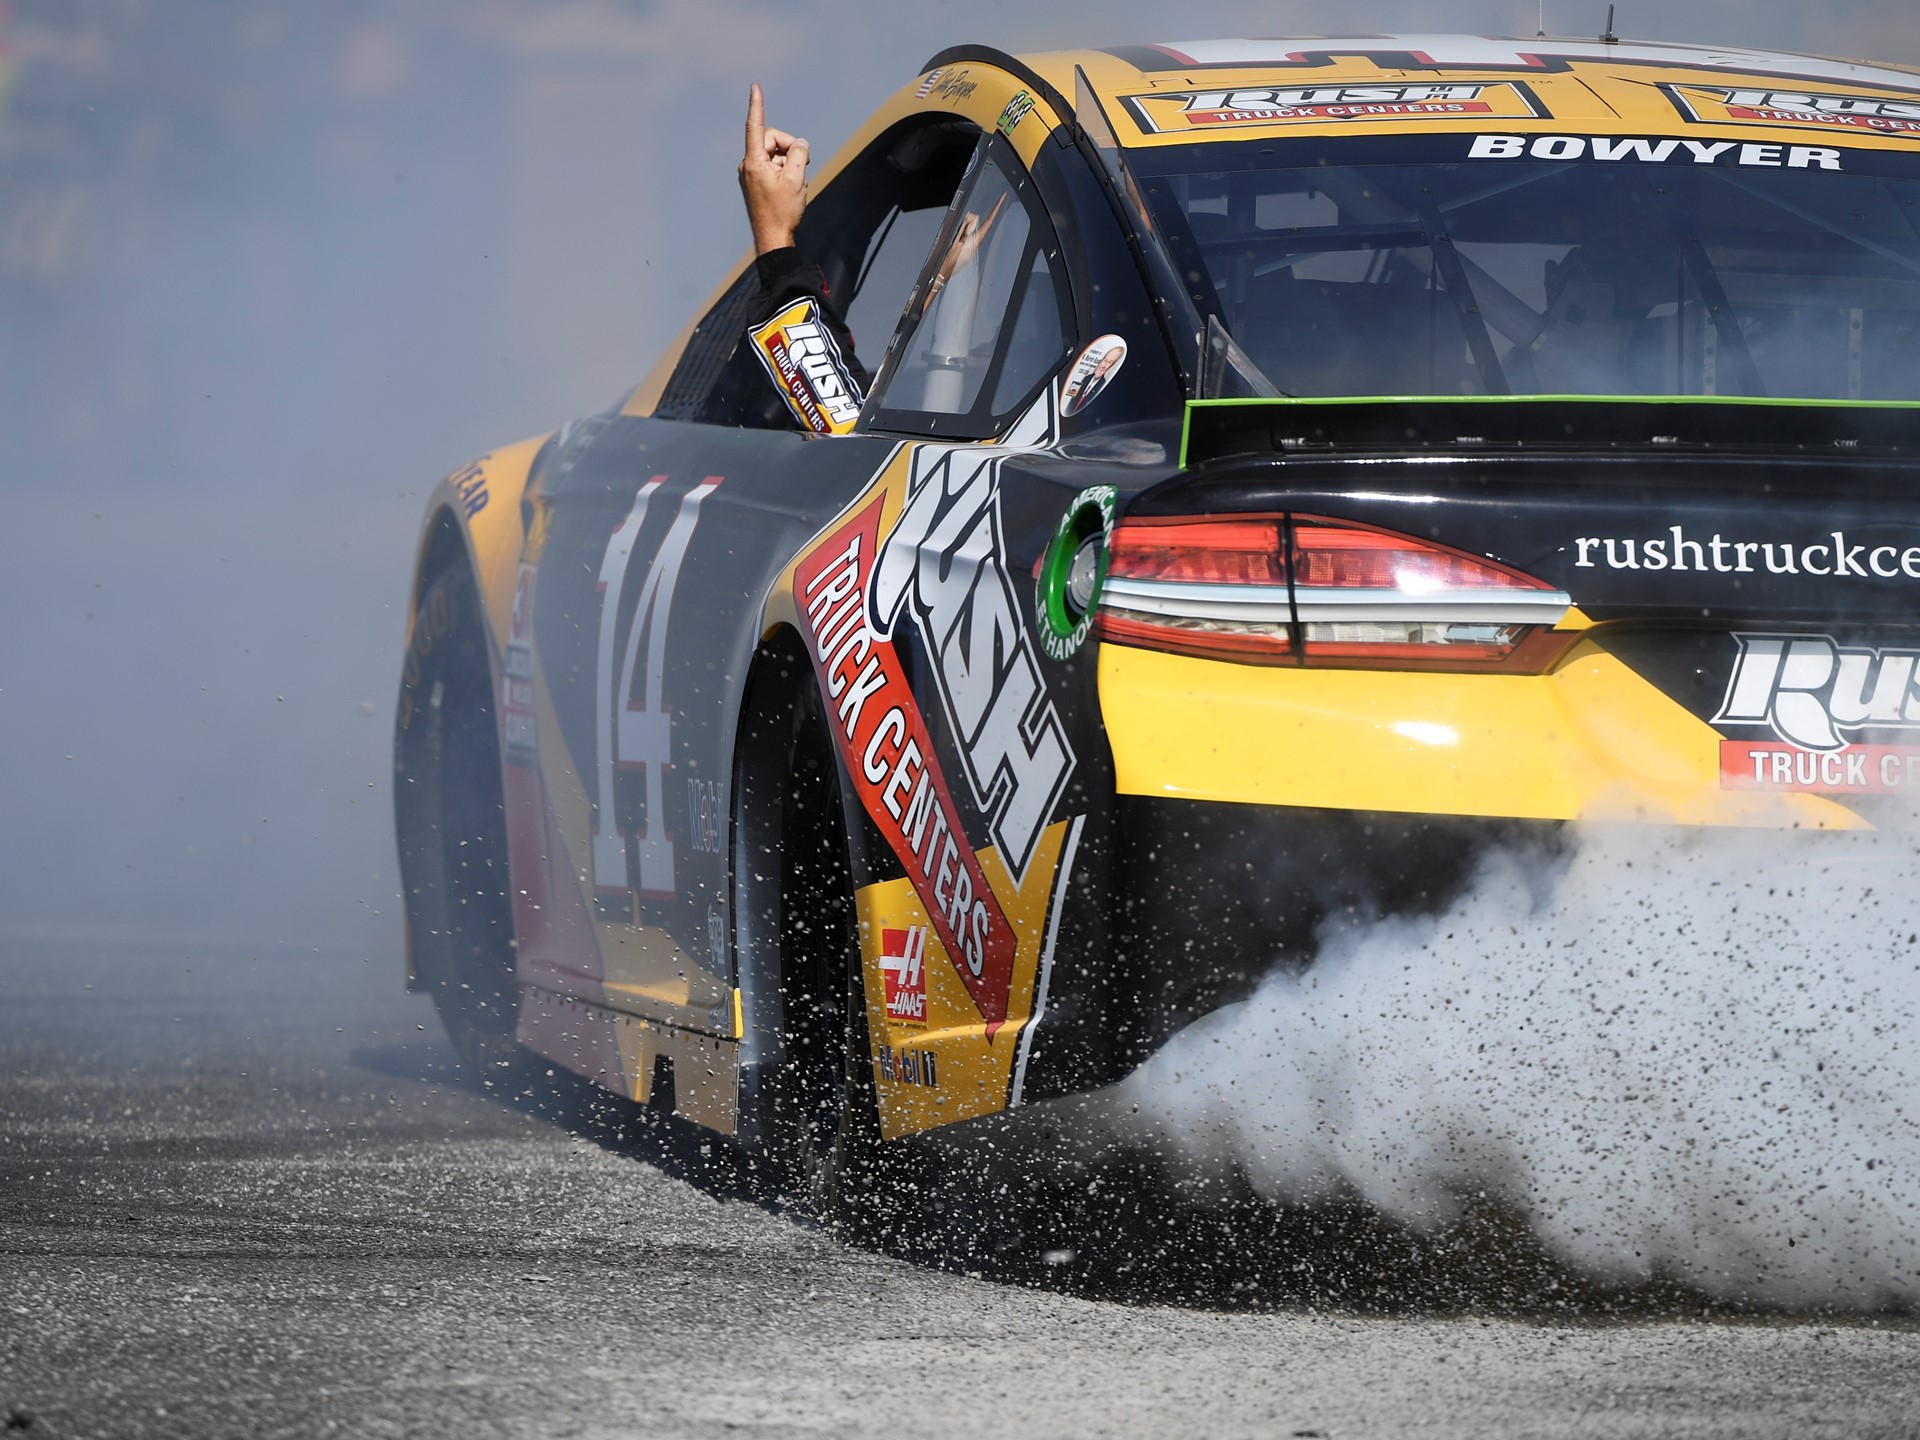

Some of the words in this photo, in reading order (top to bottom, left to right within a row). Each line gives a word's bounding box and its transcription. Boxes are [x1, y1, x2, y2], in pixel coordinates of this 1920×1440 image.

[1213, 105, 1315, 122] TRUCK
[1326, 103, 1466, 116] CENTERS
[1754, 110, 1858, 126] TRUCK
[1467, 135, 1844, 171] BOWYER
[771, 342, 797, 383] TRUCK
[791, 380, 825, 432] CENTERS
[1059, 485, 1116, 549] AMERICAN
[1037, 600, 1094, 660] ETHANOL
[593, 475, 726, 899] 14
[806, 534, 889, 740] TRUCK
[863, 708, 989, 979] CENTERS
[1750, 751, 1868, 786] TRUCK
[886, 992, 927, 1018] HAAS
[879, 1043, 921, 1085] Mobil
